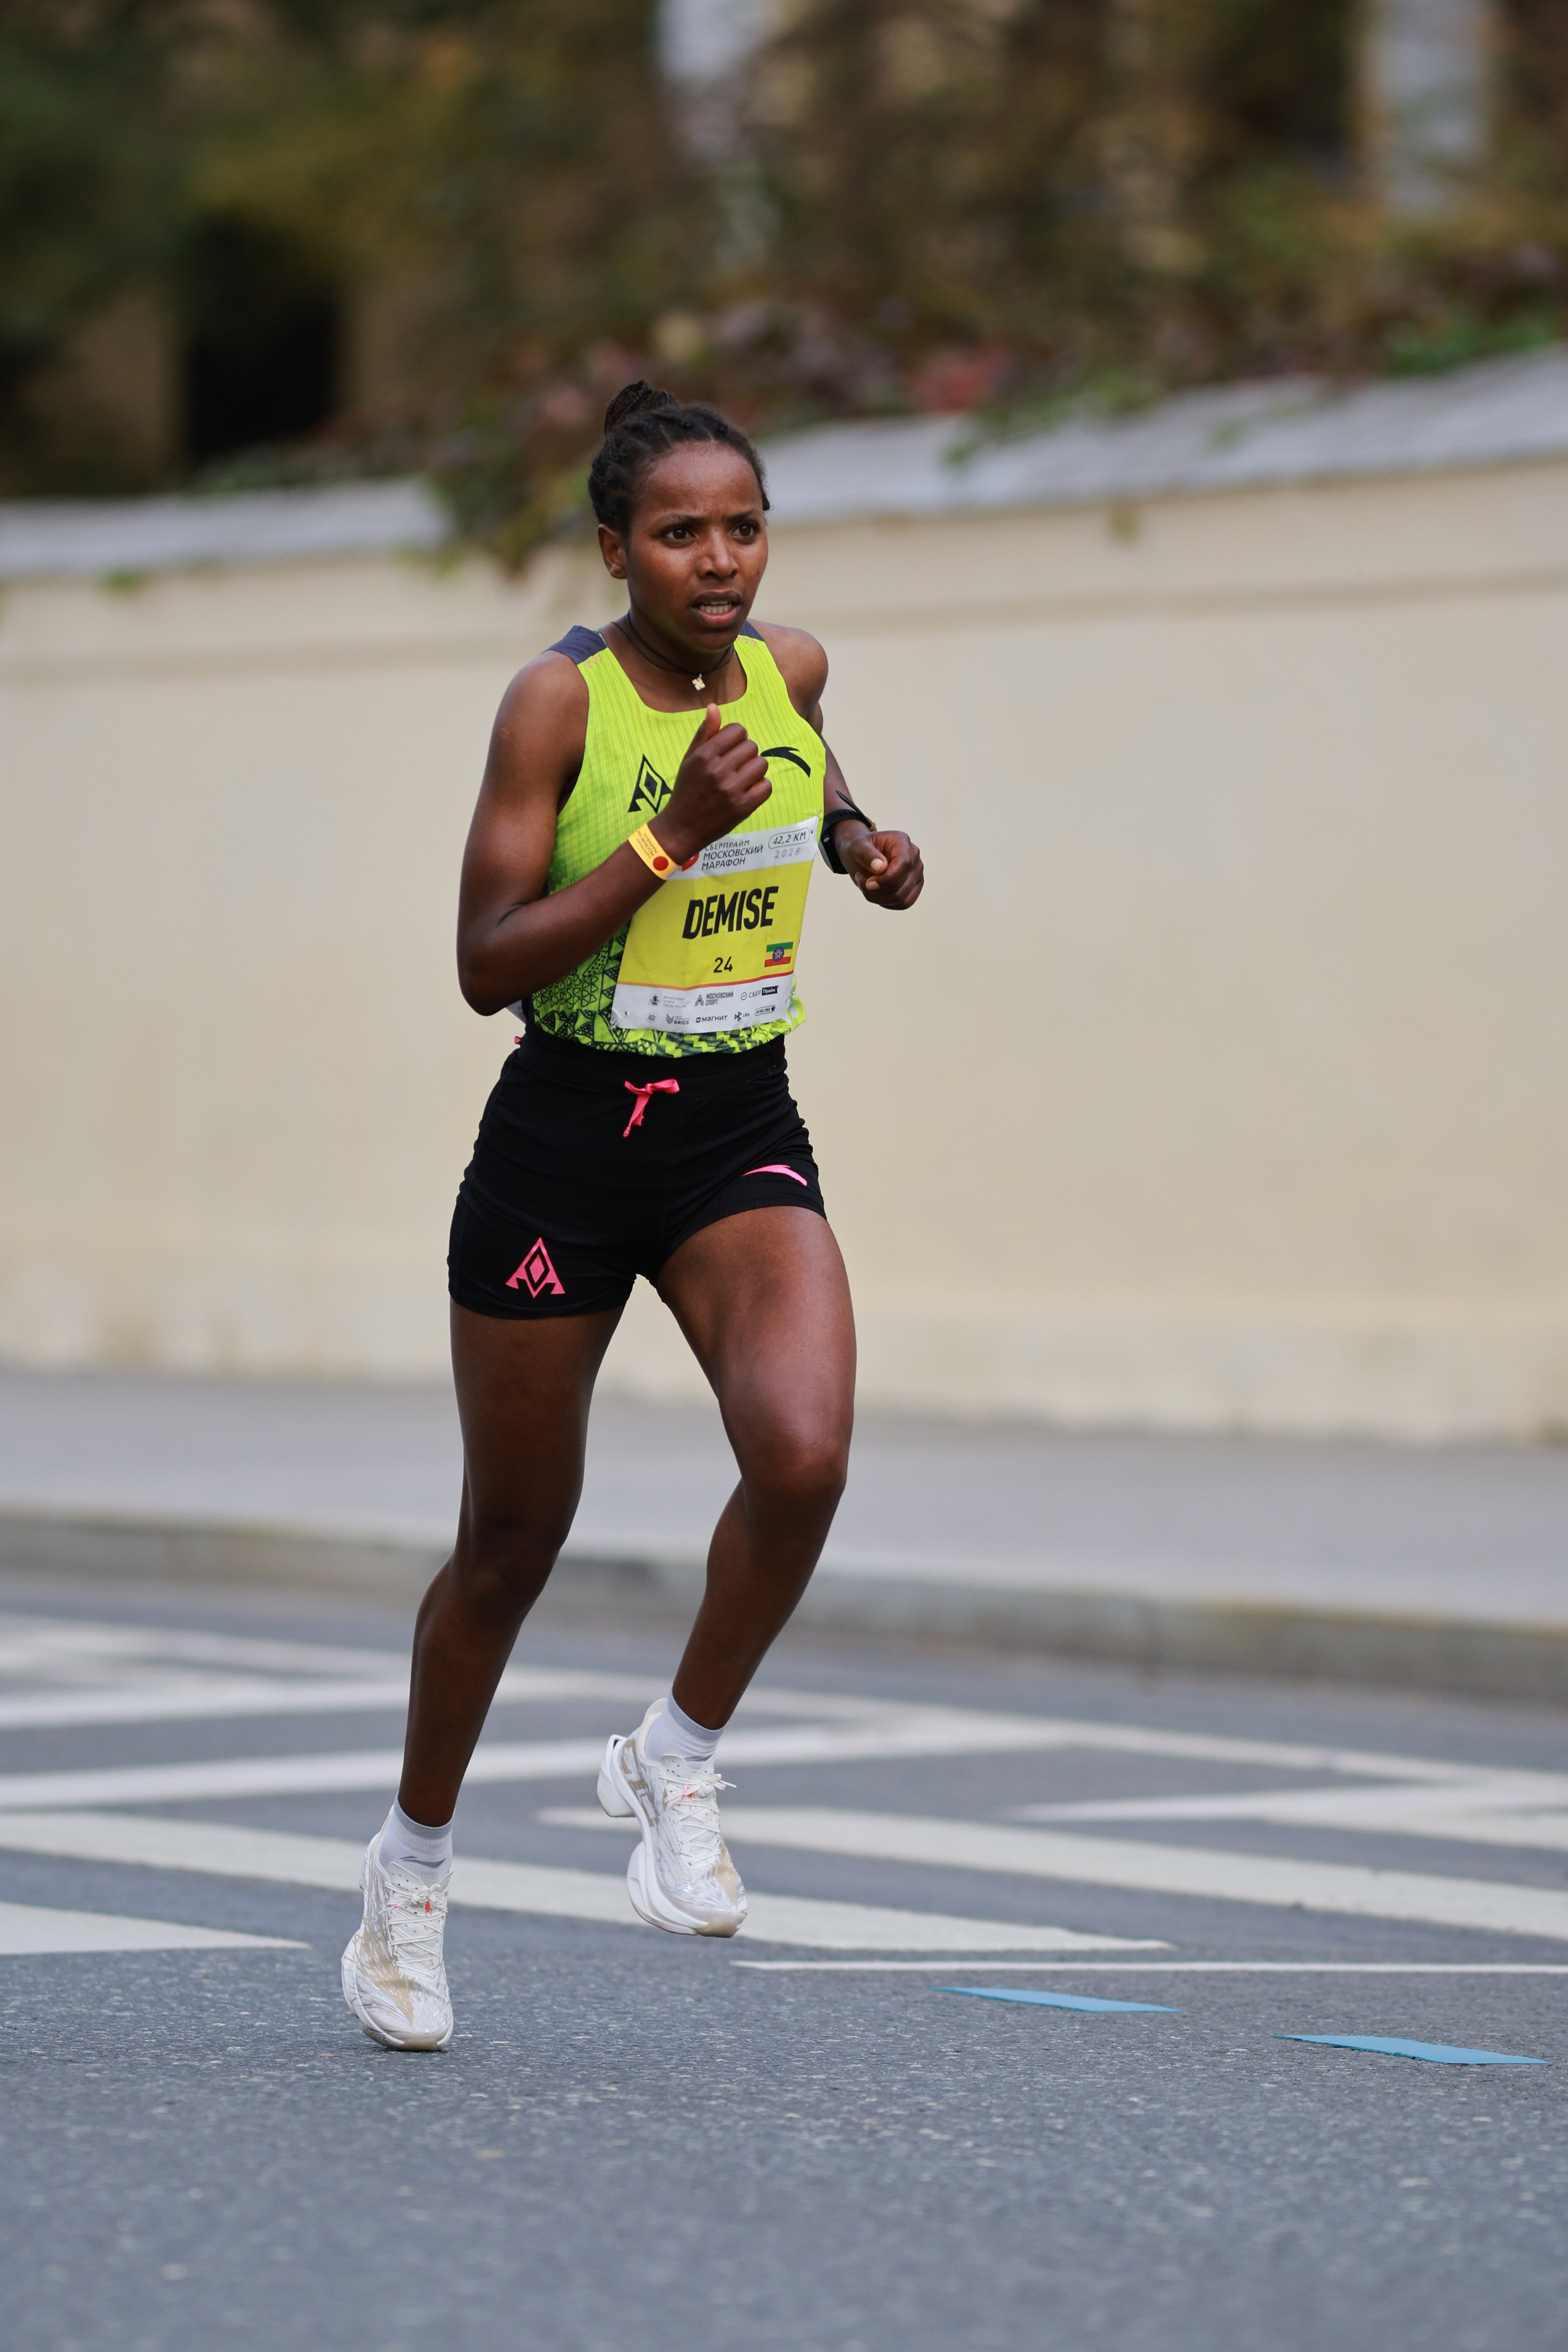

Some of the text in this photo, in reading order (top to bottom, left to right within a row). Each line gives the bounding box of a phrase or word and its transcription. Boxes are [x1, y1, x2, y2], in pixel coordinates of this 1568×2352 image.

[703, 844, 763, 861] МОСКОВСКИЙ
[705, 840, 749, 851] СБЕРПРАЙМ
[701, 857, 745, 870] МАРАФОН
[682, 886, 778, 940] DEMISE
[713, 956, 733, 973] 24
